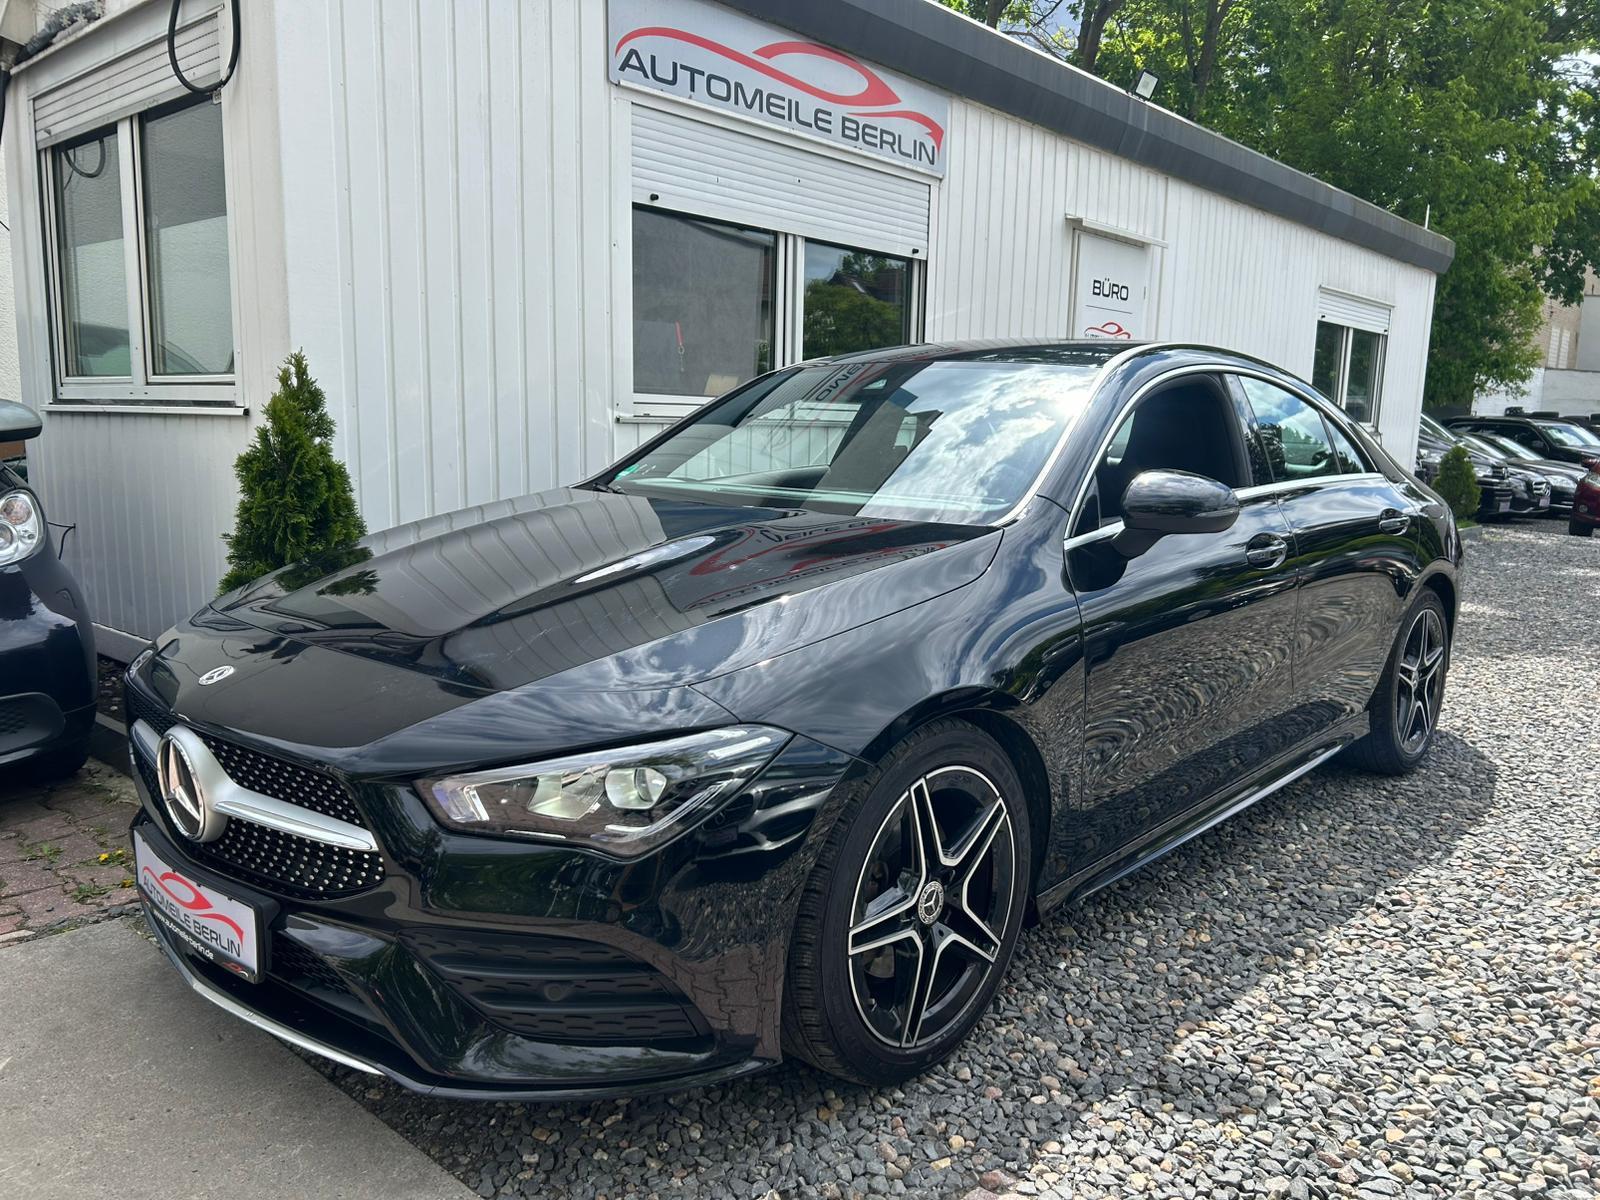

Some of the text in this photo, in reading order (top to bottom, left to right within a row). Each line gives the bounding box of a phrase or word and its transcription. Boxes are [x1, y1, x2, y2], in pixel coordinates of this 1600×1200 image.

[618, 48, 935, 165] AUTOMEILE BERLIN
[1092, 277, 1129, 301] BÜRO
[194, 919, 240, 957] BERLIN
